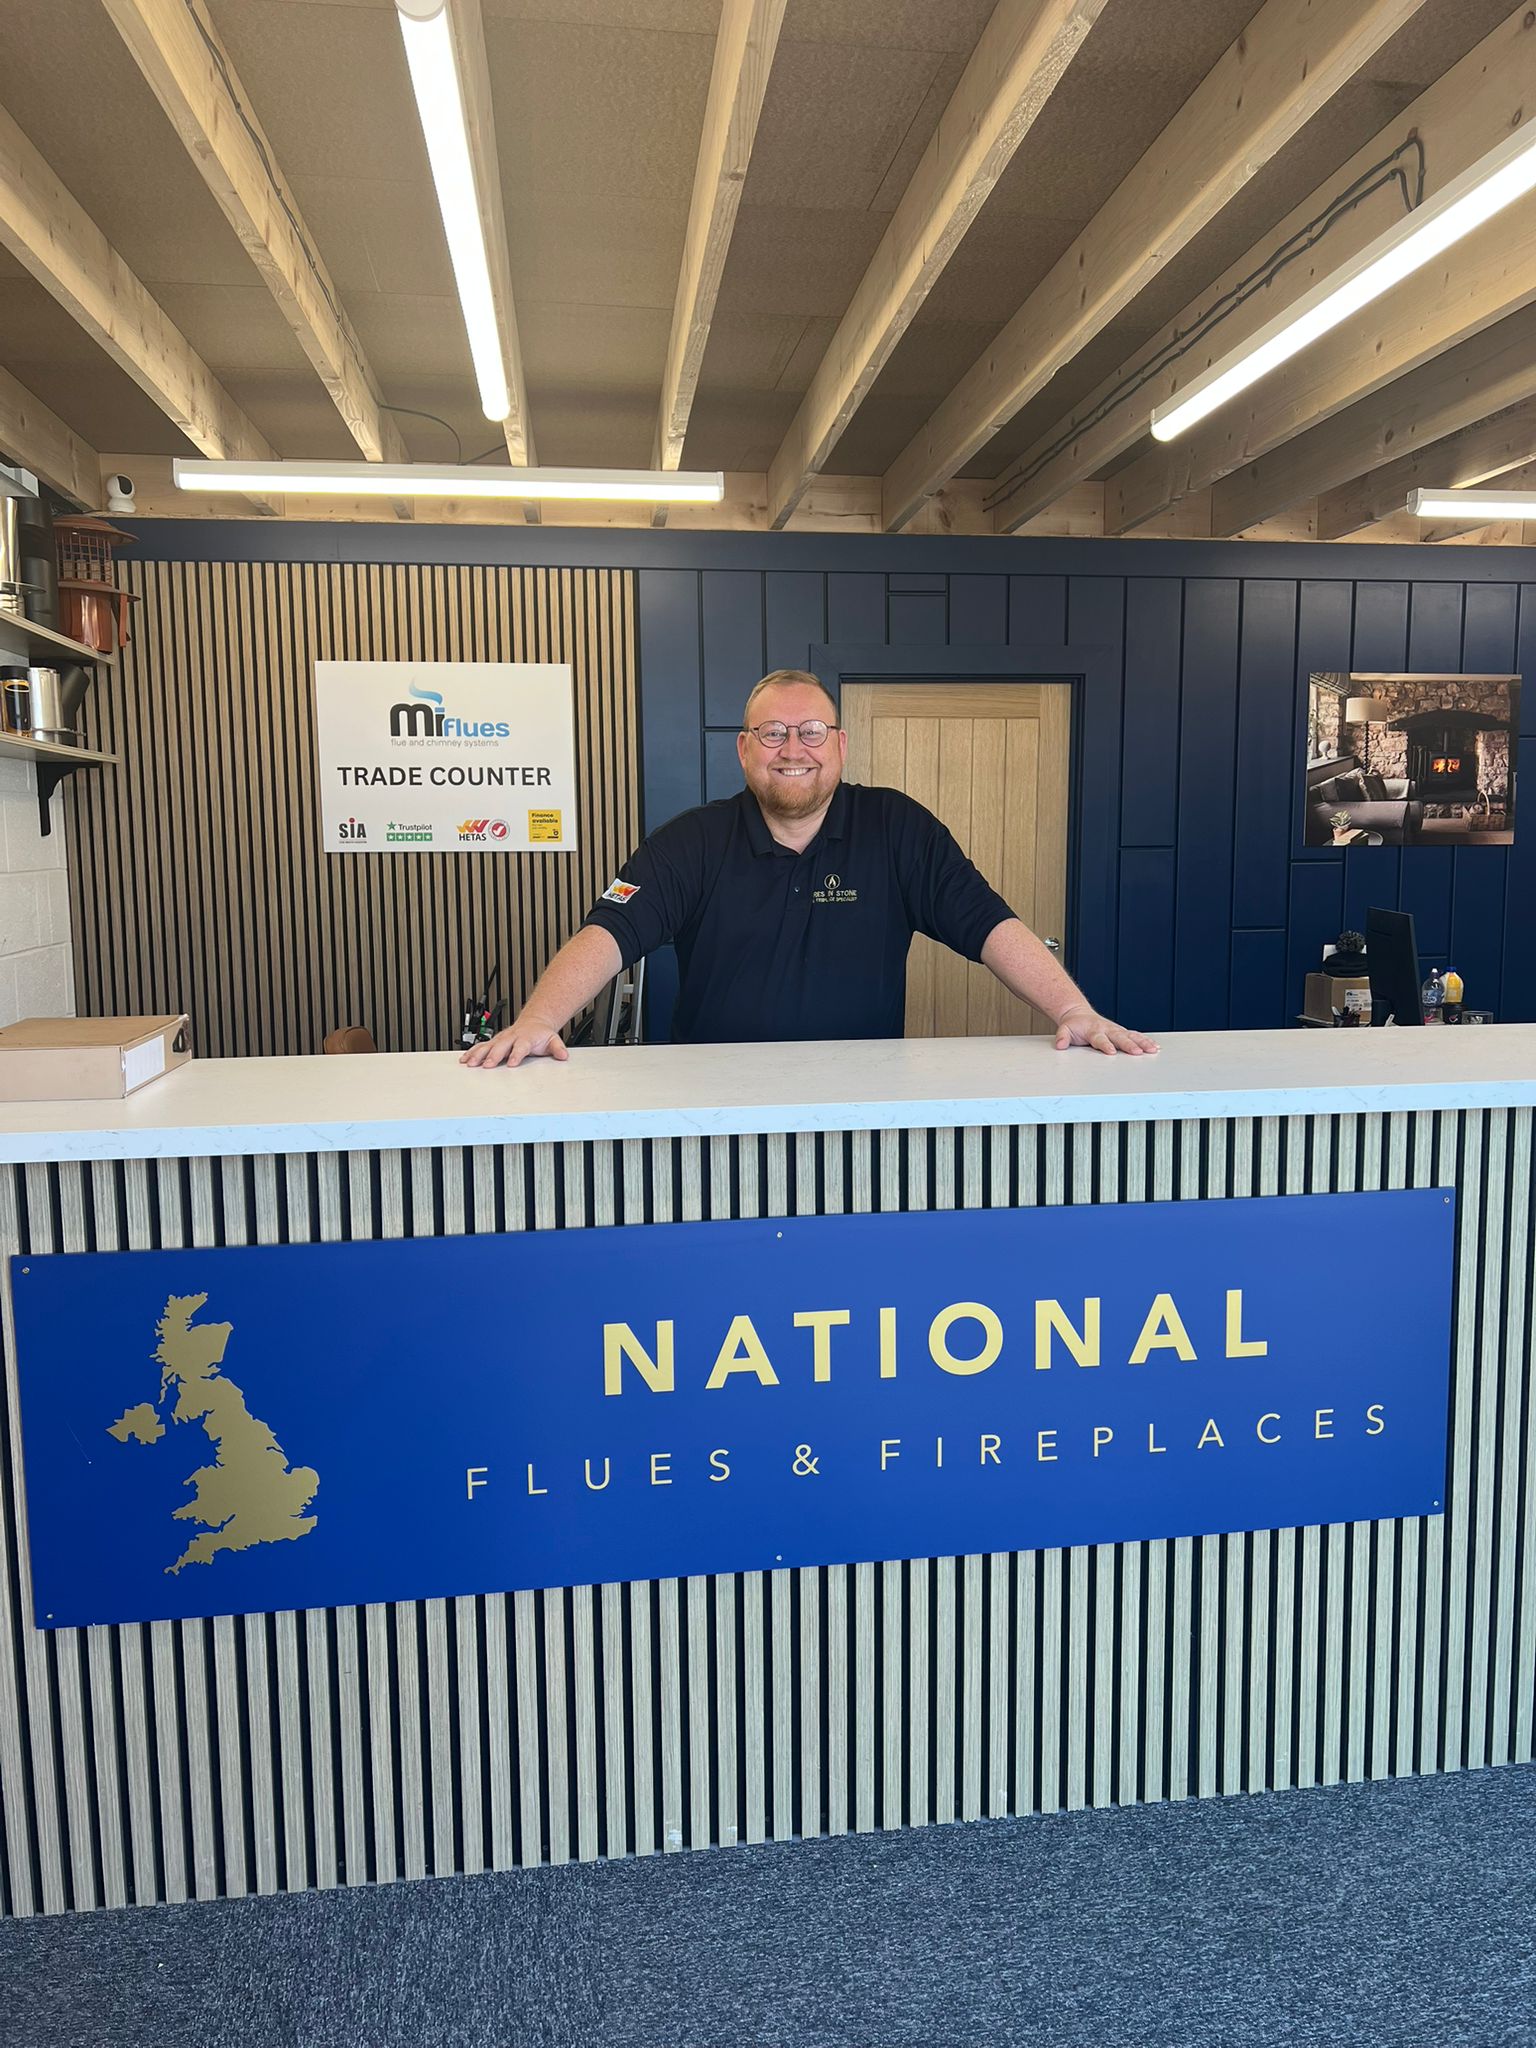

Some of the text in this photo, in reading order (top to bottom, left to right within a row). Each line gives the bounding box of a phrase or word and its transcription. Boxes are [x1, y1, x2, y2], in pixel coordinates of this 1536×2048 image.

[391, 739, 499, 748] flue and chimney systems
[337, 766, 552, 786] TRADE COUNTER
[398, 823, 433, 832] Trustpilot
[458, 832, 487, 842] HETAS
[836, 889, 857, 897] STONE
[602, 1288, 1269, 1397] NATIONAL
[466, 1403, 1387, 1501] FLUES & FIREPLACES
